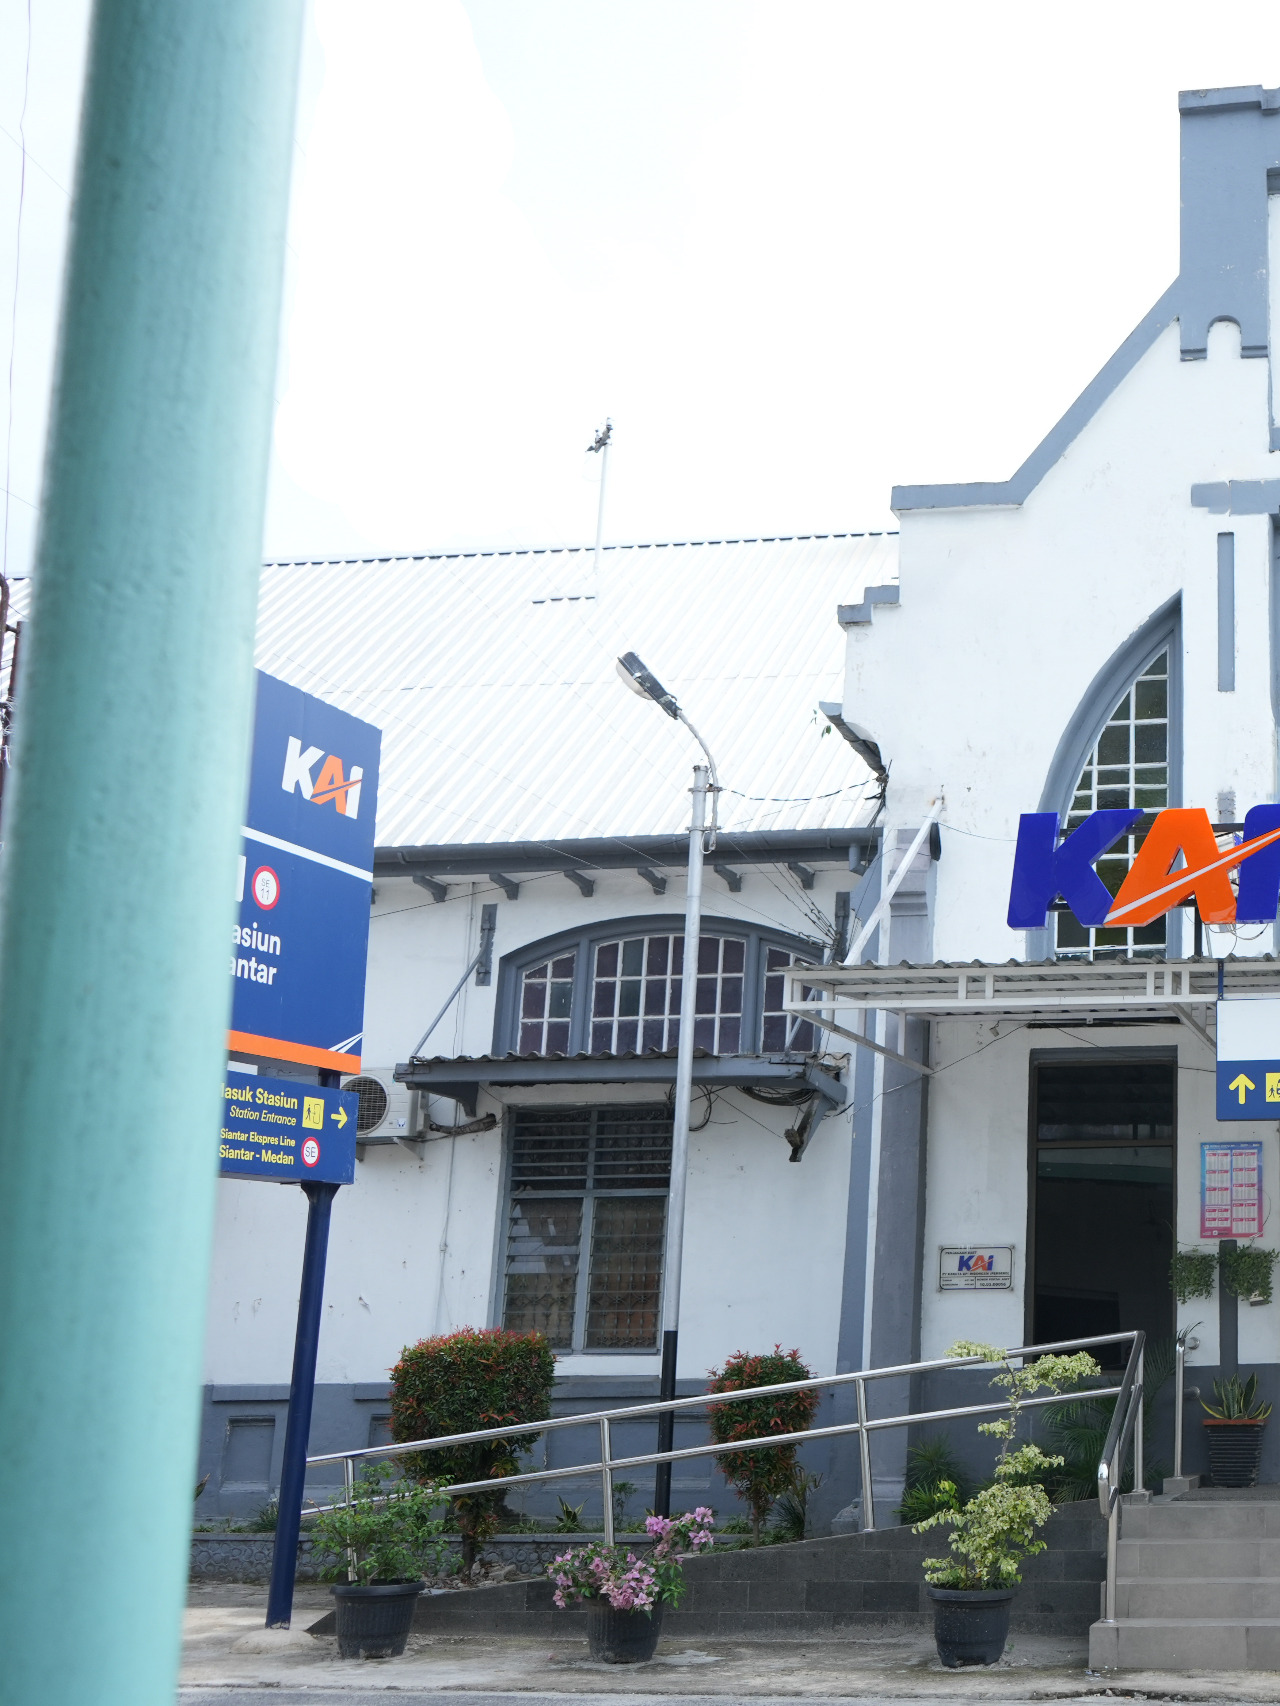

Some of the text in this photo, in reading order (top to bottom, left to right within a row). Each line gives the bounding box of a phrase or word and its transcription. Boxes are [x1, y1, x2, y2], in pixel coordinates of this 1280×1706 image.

[281, 735, 364, 820] KAI
[232, 922, 281, 956] asiun
[229, 955, 277, 986] antar
[255, 1087, 298, 1110] Stasiun
[229, 1105, 297, 1127] Station Entrance
[220, 1128, 296, 1147] Siantar Ekspres Line
[219, 1145, 255, 1161] Siantar
[261, 1149, 295, 1165] Medan
[304, 1146, 316, 1158] SE
[958, 1255, 994, 1271] KAI
